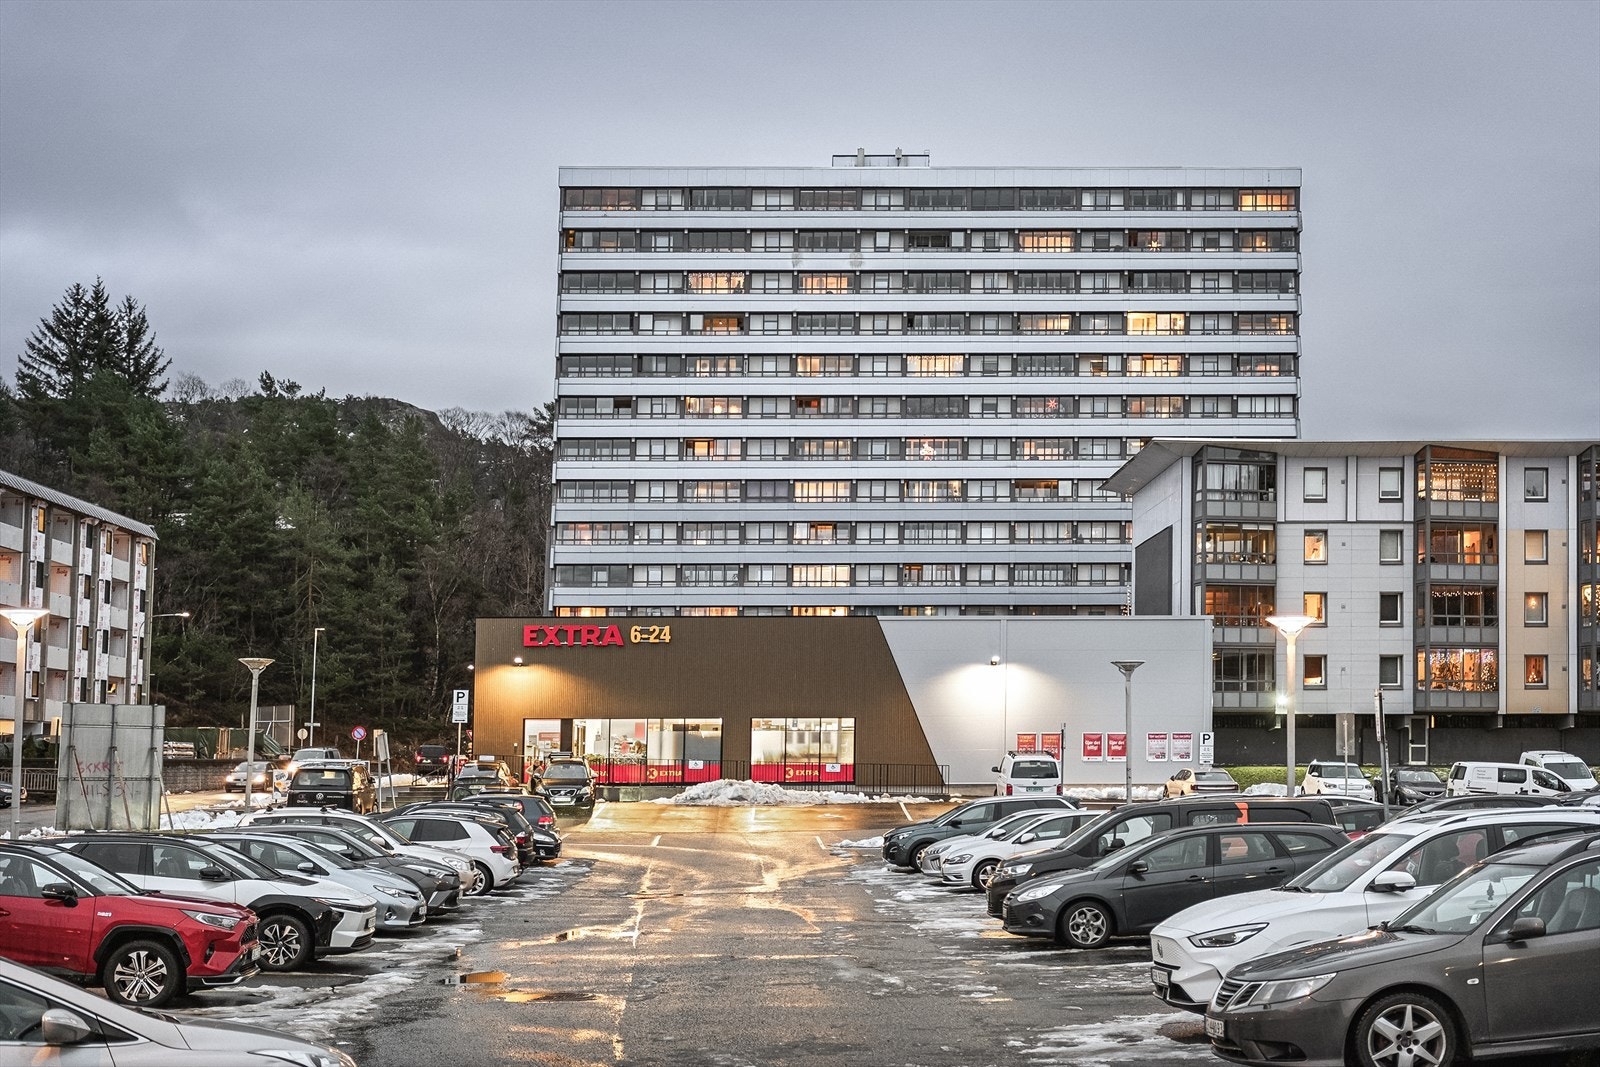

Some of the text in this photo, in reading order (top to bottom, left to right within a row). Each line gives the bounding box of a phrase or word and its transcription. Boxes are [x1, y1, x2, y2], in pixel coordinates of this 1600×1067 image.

[523, 624, 671, 647] EXTRA 6-24
[456, 691, 466, 703] P
[1202, 733, 1211, 744] P
